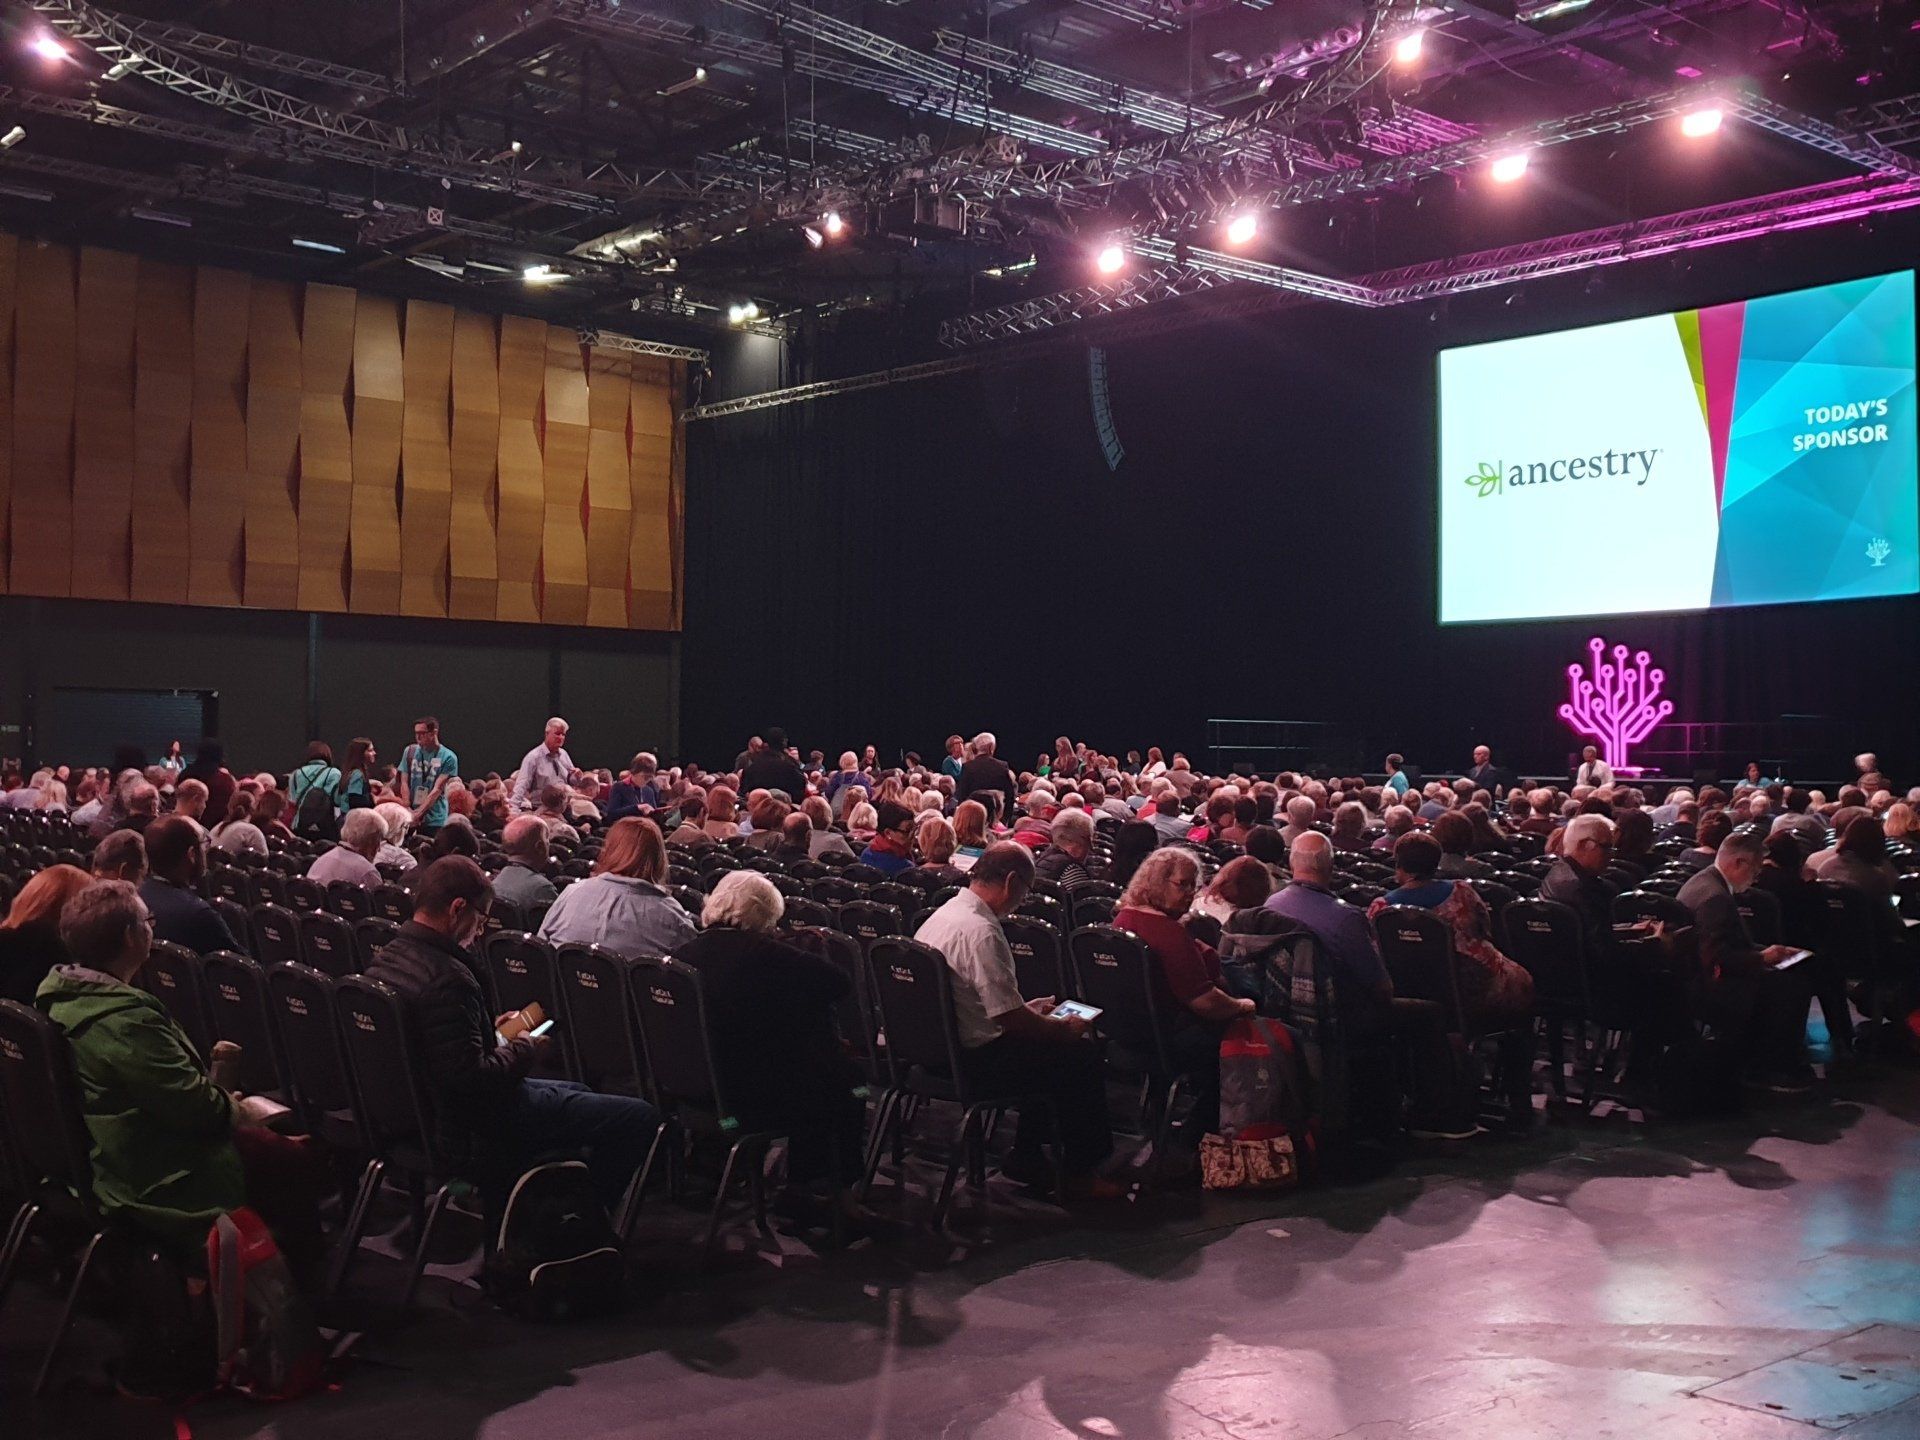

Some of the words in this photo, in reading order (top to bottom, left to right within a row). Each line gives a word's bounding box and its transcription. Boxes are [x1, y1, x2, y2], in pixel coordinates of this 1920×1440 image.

[1804, 398, 1888, 425] TODAY'S
[1792, 424, 1888, 452] SPONSOR
[1508, 448, 1658, 486] ancestry
